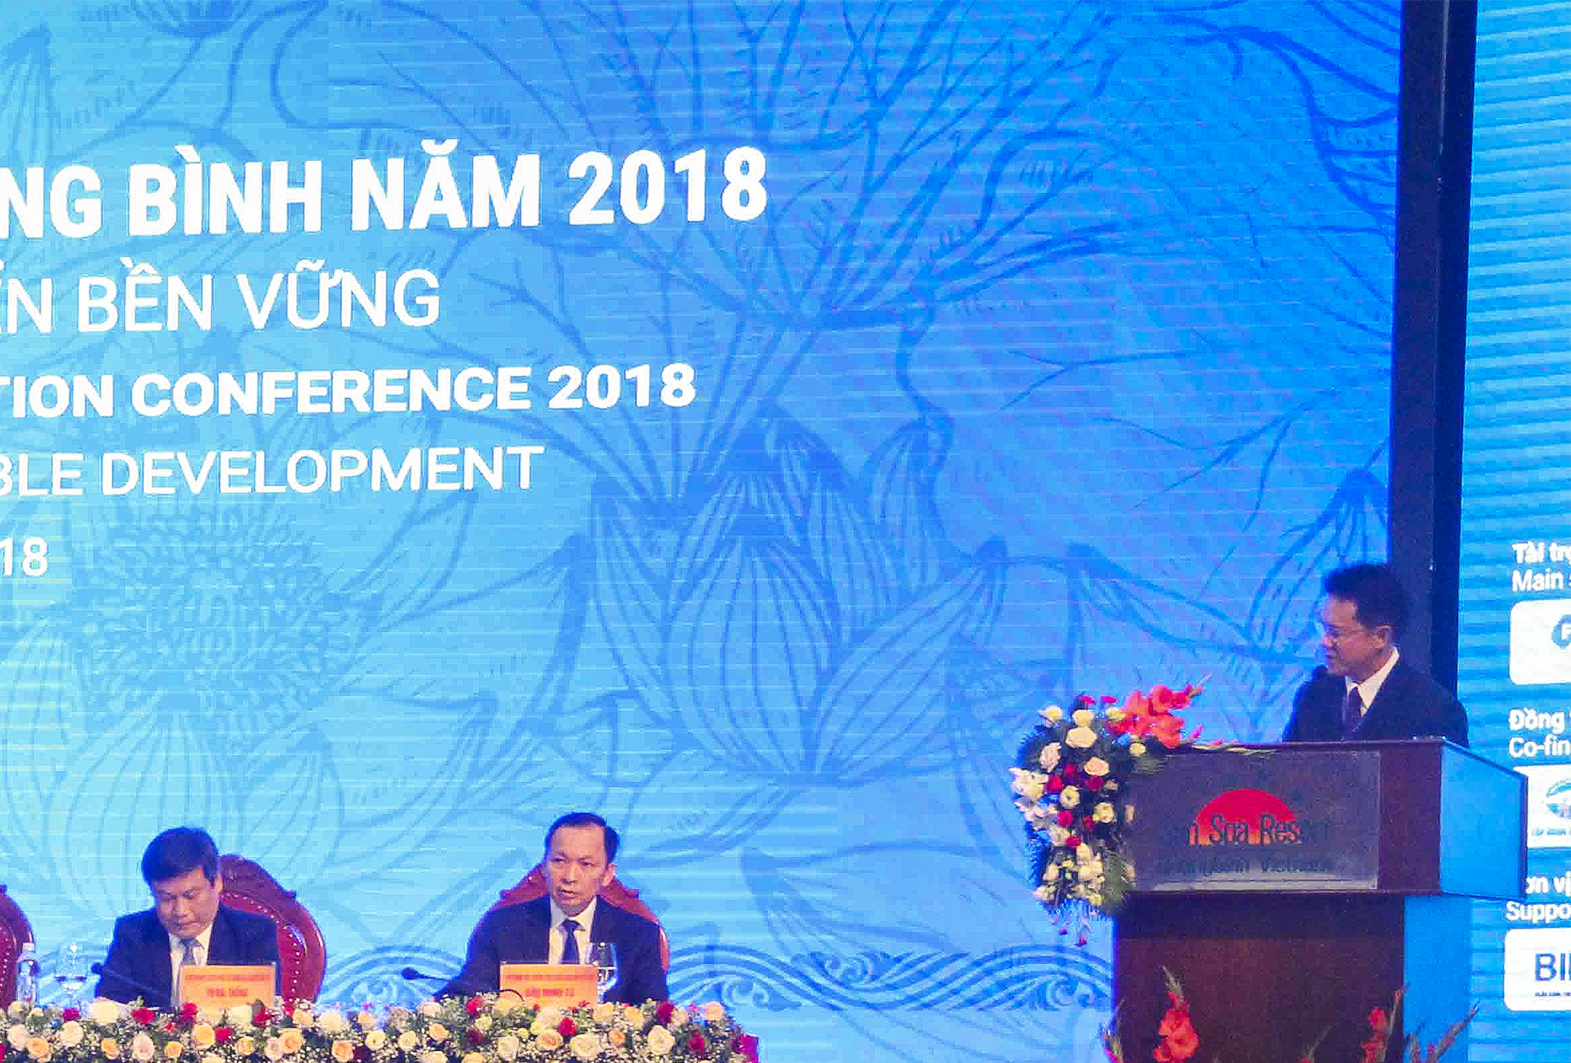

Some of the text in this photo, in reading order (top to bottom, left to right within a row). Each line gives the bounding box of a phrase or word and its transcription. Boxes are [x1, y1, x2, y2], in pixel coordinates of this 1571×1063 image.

[129, 145, 322, 236] BÌNH
[352, 139, 540, 231] NĂM
[569, 146, 767, 225] 2018
[78, 256, 212, 333] BỀN
[236, 259, 439, 329] VỮNG
[132, 367, 531, 417] CONFERENCE
[548, 363, 696, 409] 2018
[102, 446, 544, 495] DEVELOPMENT
[1512, 568, 1564, 592] Main
[1508, 708, 1565, 734] Đồng
